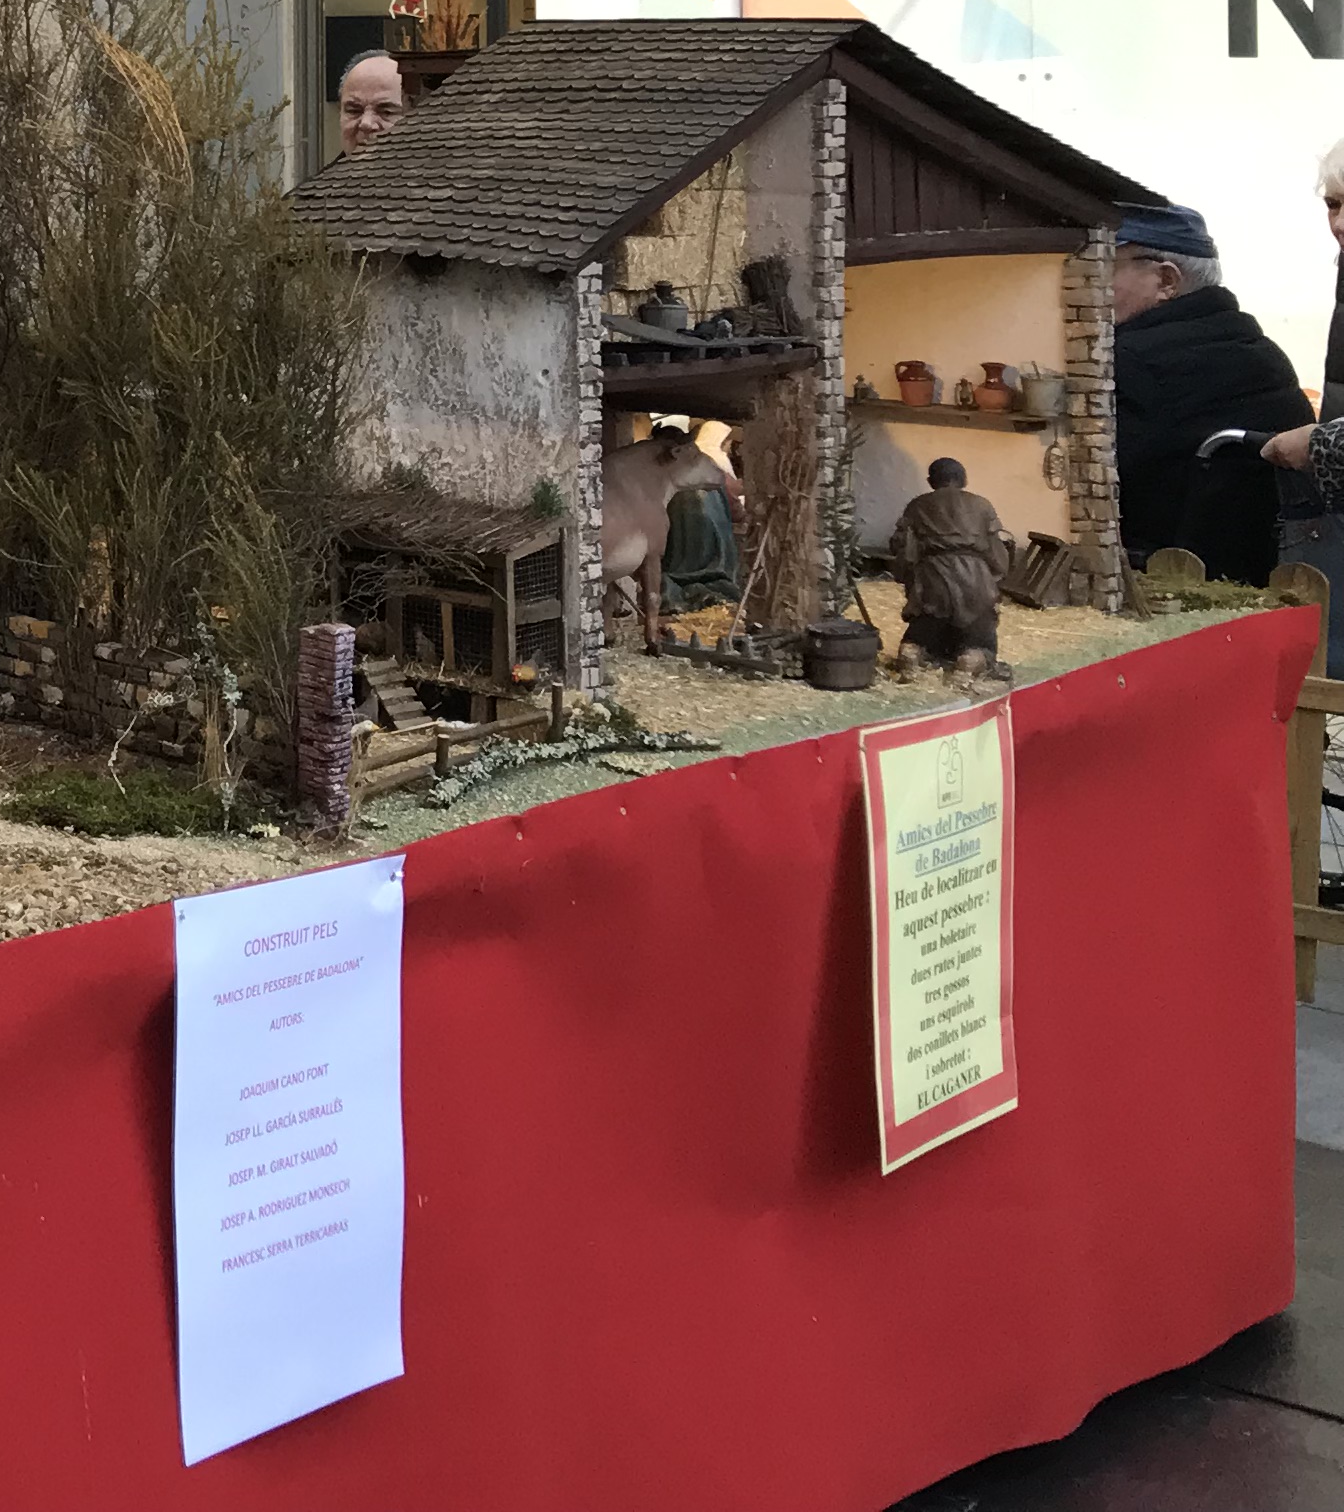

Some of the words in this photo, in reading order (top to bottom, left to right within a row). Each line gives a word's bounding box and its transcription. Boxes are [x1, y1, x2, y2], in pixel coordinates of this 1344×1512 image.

[896, 823, 933, 849] Amics
[934, 814, 952, 837] del
[954, 801, 997, 831] Pessebre
[915, 853, 929, 874] de
[932, 837, 981, 867] Badalona
[895, 888, 918, 910] Heu
[921, 881, 934, 901] de
[936, 863, 984, 895] localitzar
[903, 909, 938, 939] aquest
[941, 893, 984, 928] pessebre
[243, 926, 310, 957] CONSTRUIT
[312, 920, 338, 941] PELS
[245, 984, 261, 999] DEL
[263, 972, 303, 994] PESSEBRE
[304, 969, 315, 984] DE
[925, 987, 942, 1004] tres
[269, 1011, 305, 1032] AUTORS:
[920, 1015, 936, 1032] uns
[937, 994, 975, 1024] esquirols
[931, 1048, 966, 1077] sobretot
[239, 1077, 279, 1101] JOAQUIM
[280, 1070, 305, 1088] CANO
[306, 1063, 329, 1080] FONT
[917, 1090, 931, 1110] EL
[932, 1064, 982, 1102] CAGANER
[224, 1127, 251, 1147] JOSEP
[270, 1153, 299, 1173] GIRALT
[220, 1211, 246, 1232] JOSEP
[222, 1246, 266, 1273] FRANCESC
[266, 1237, 293, 1258] SERRA
